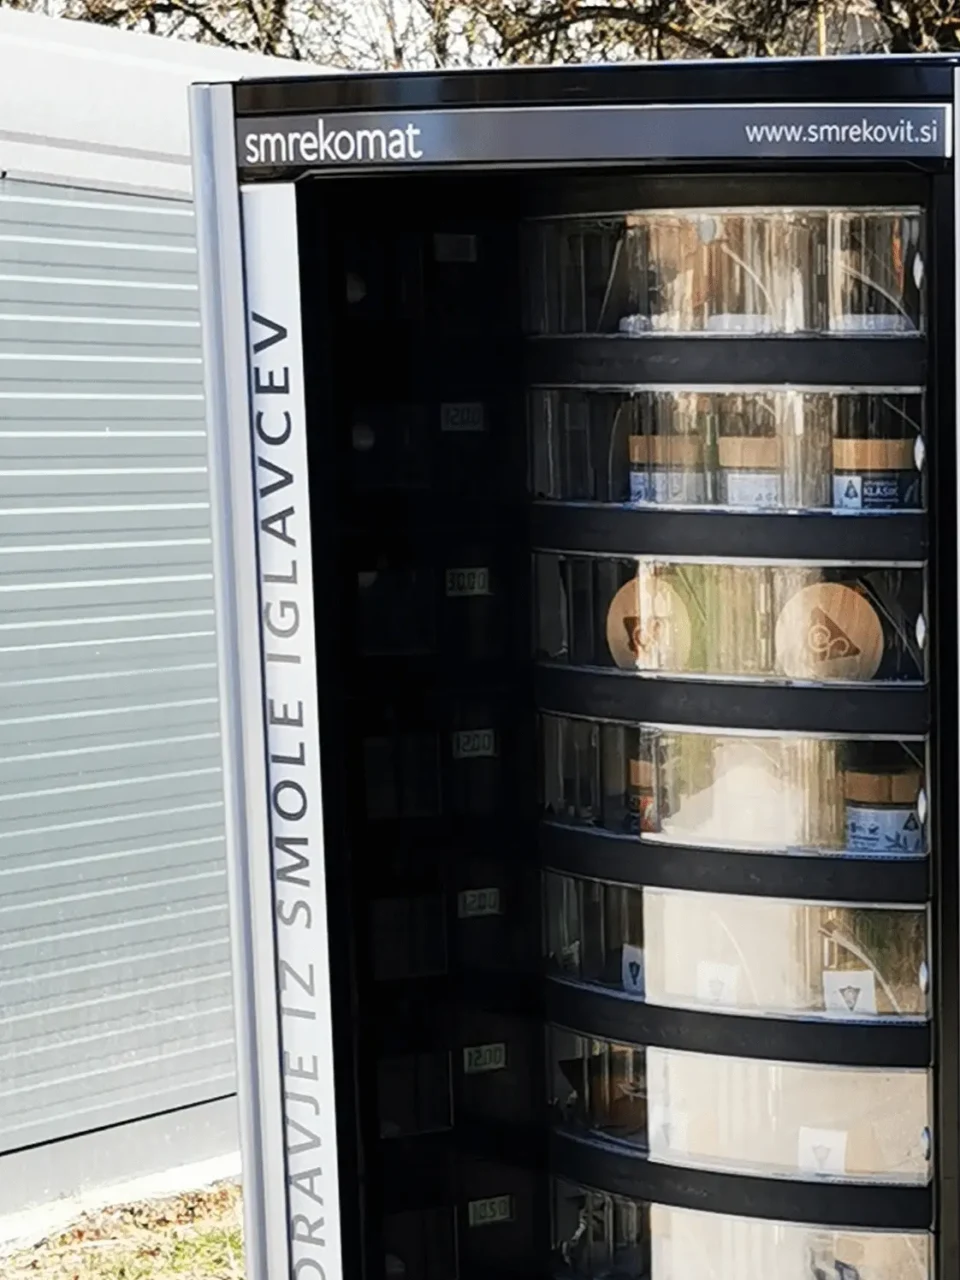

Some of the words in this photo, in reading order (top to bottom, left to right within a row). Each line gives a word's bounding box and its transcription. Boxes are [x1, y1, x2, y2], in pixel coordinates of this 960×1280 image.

[245, 119, 423, 163] smrekomat
[745, 118, 938, 143] www.smrekovit.si
[251, 311, 302, 665] IGLAVCEV
[269, 699, 313, 930] SMOLE
[279, 963, 316, 1021] IZ
